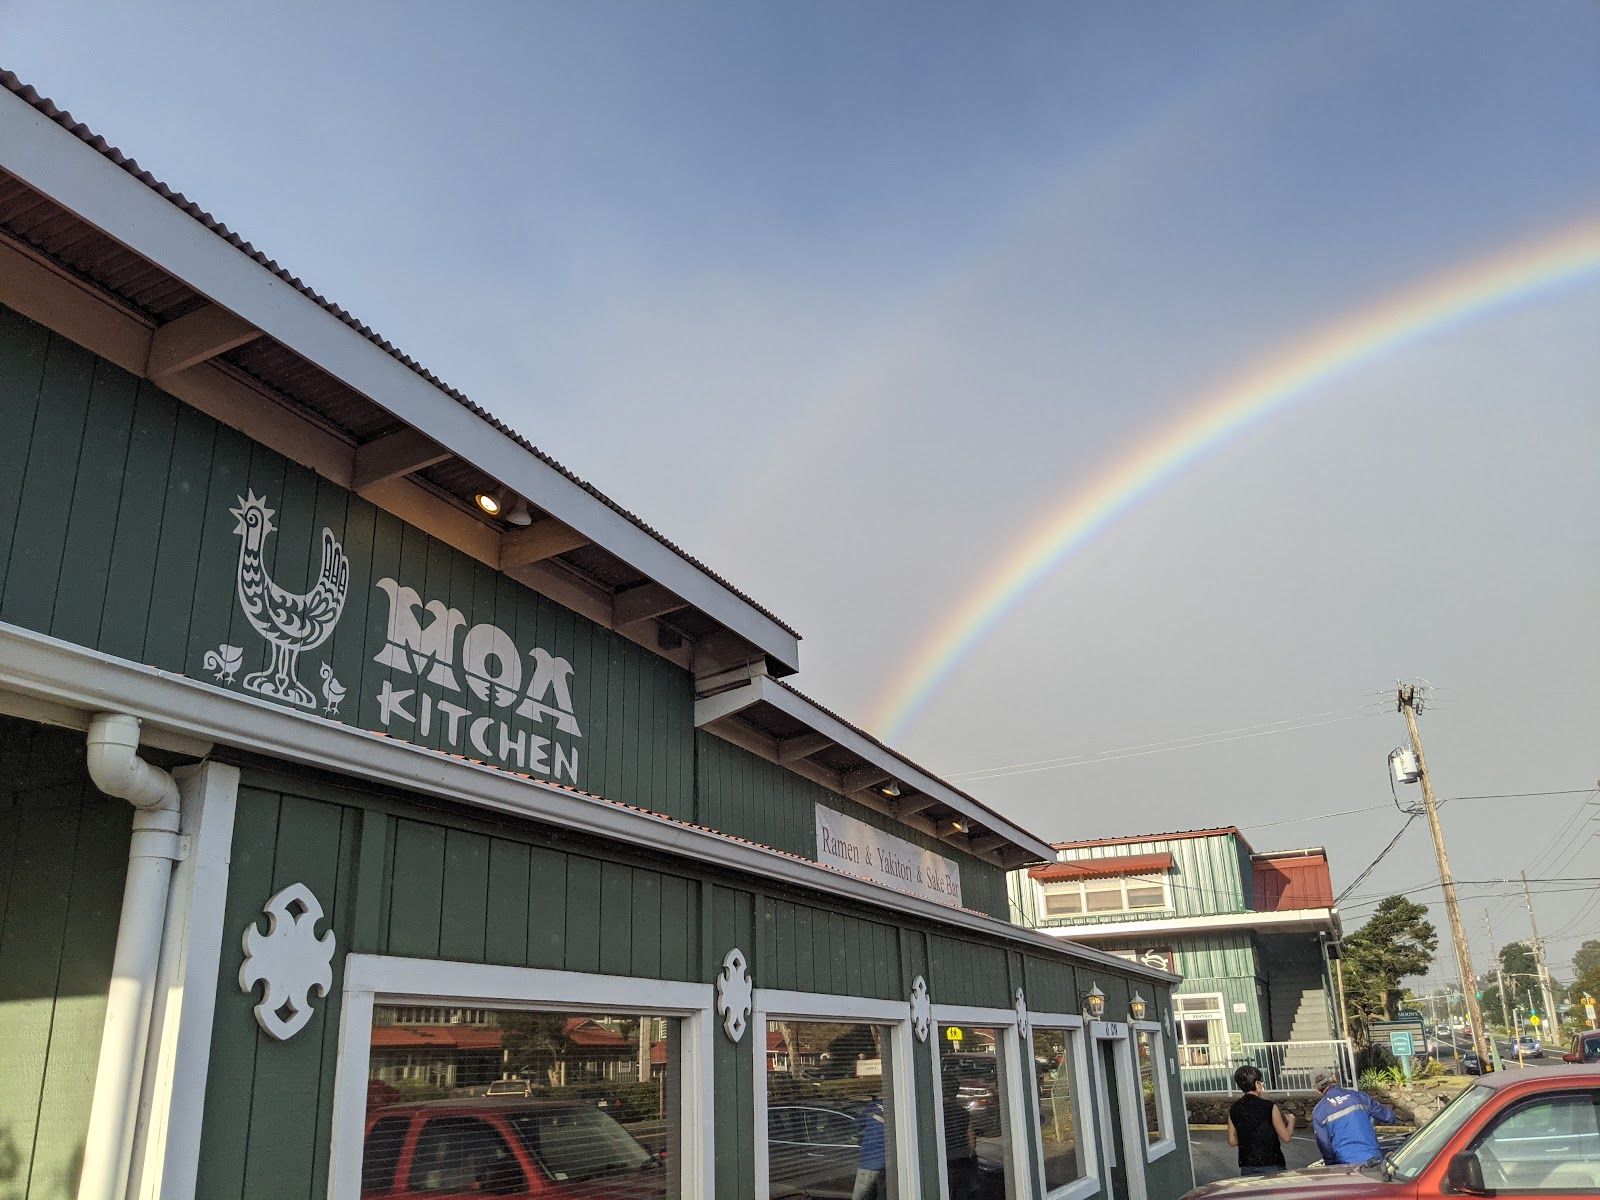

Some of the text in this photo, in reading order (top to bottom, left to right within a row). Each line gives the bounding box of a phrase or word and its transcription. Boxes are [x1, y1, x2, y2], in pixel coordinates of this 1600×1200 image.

[373, 577, 582, 737] MOA
[376, 680, 578, 784] KITCHEN
[821, 826, 959, 898] Ramen & Yakitori & Sake Bar
